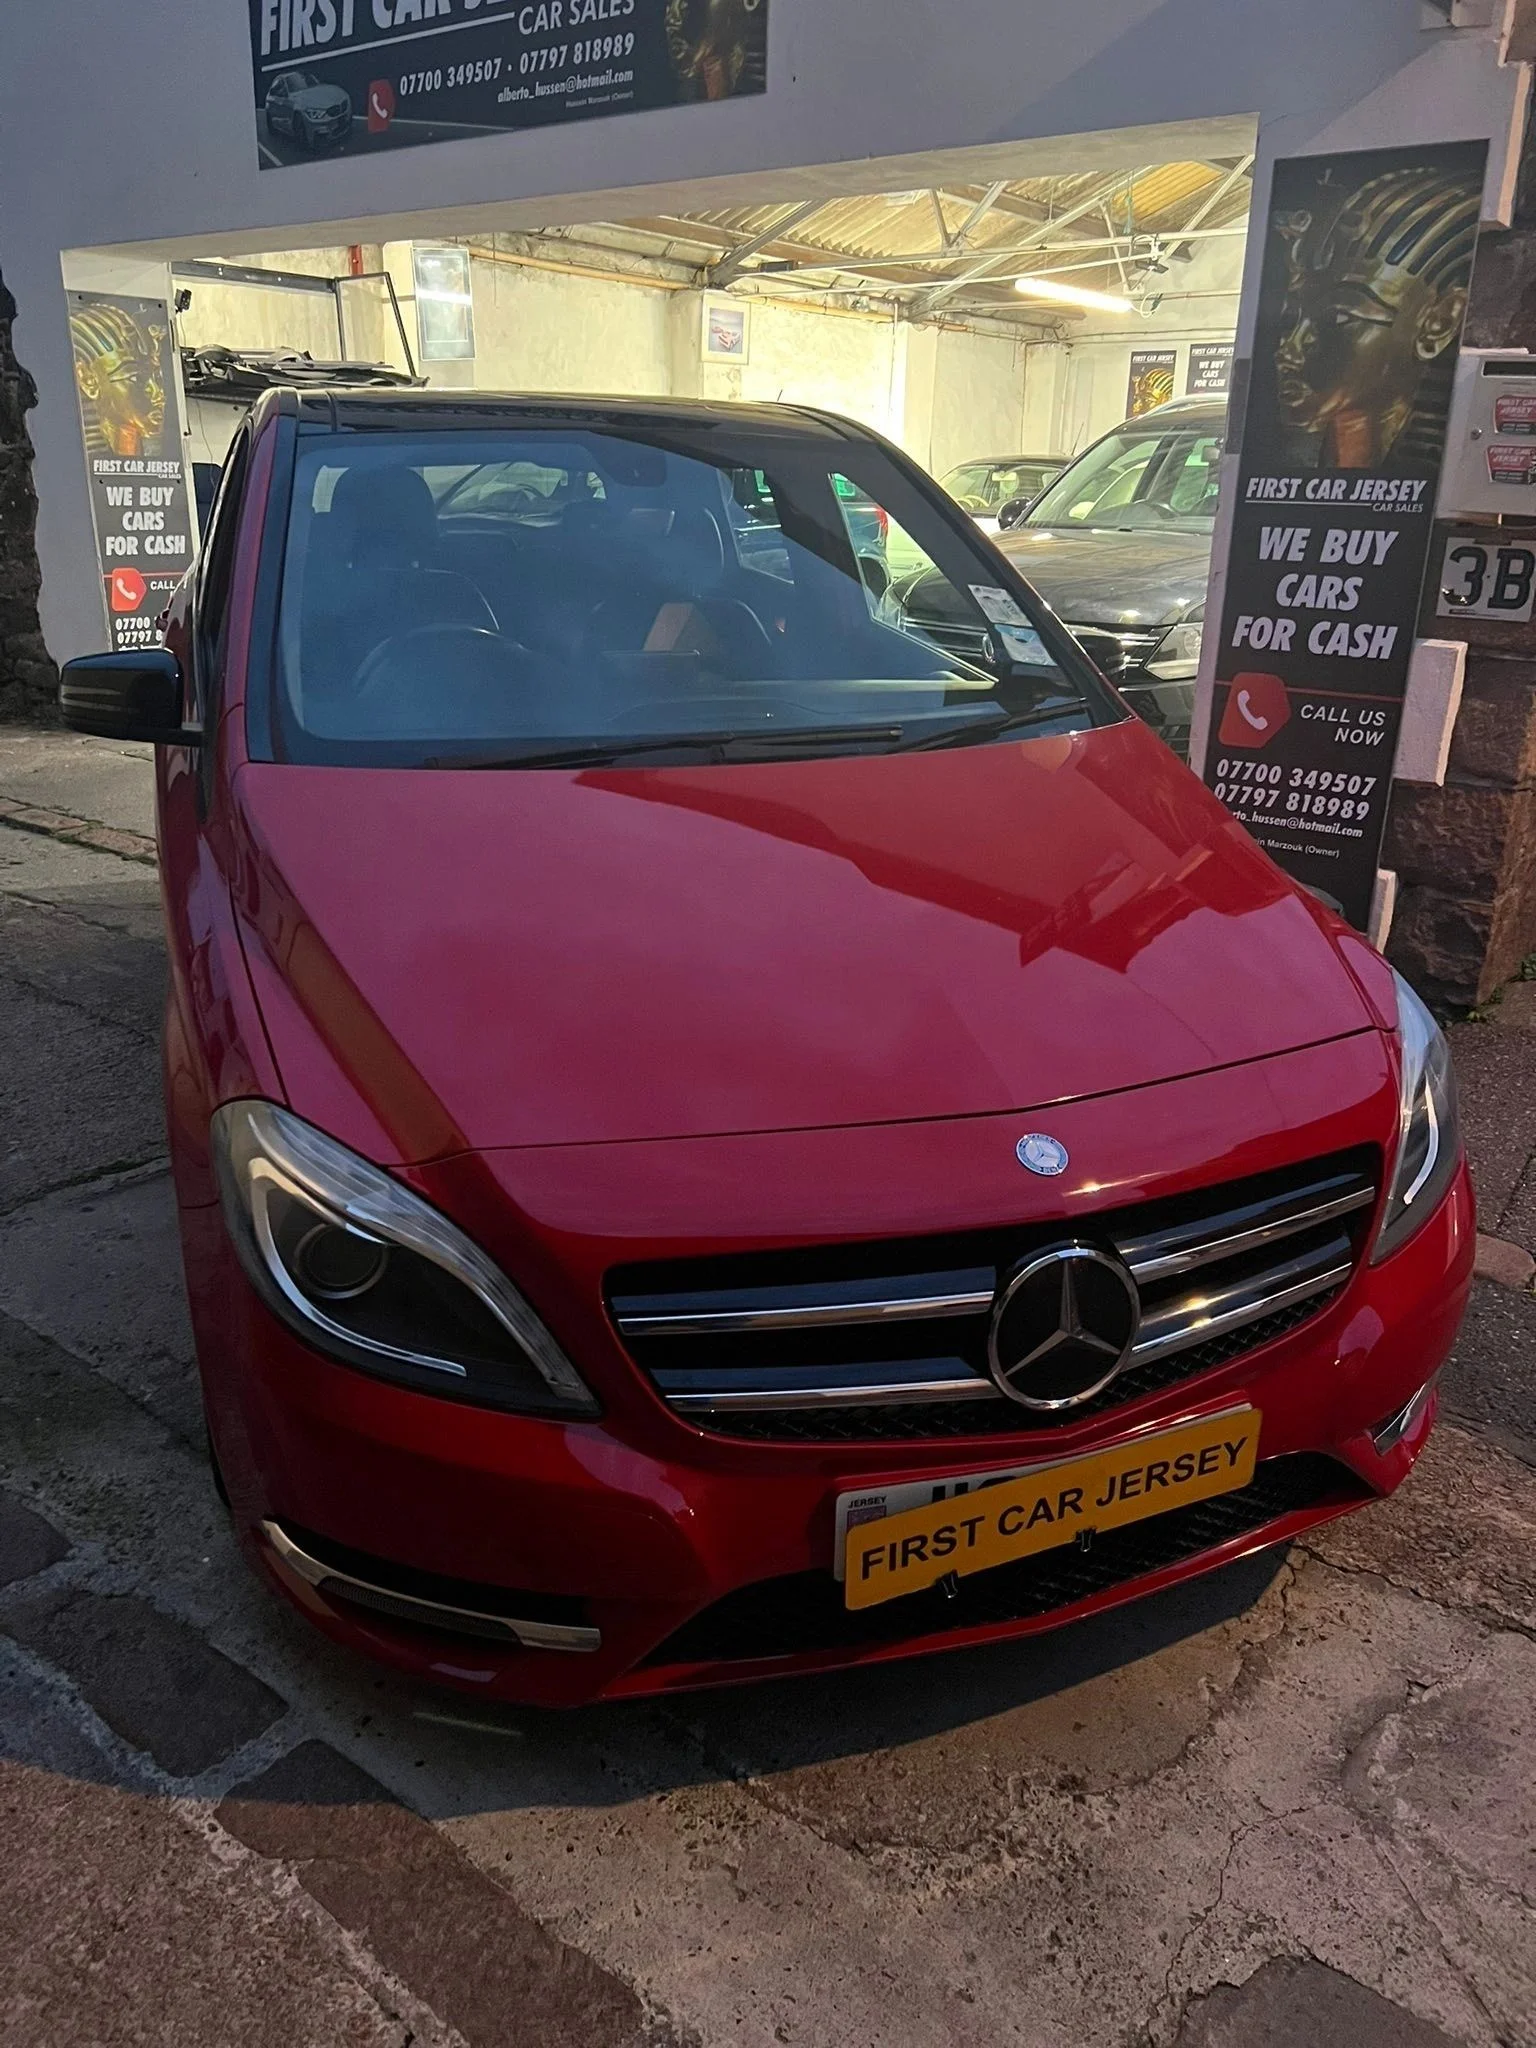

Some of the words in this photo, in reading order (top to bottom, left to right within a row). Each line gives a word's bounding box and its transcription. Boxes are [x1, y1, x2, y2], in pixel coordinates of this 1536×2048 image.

[518, 1, 563, 35] CAR
[568, 0, 636, 26] SALES
[400, 69, 442, 96] 07700
[446, 57, 502, 87] 349507
[519, 44, 568, 74] 07797
[573, 32, 635, 65] 818989
[497, 69, 633, 102] alberto_hussen@hotmail.com
[93, 459, 122, 472] FIRST
[123, 460, 145, 473] CAR
[146, 461, 180, 474] JERSEY
[106, 486, 133, 506] WE
[140, 486, 174, 506] BUY
[1246, 477, 1302, 499] FIRST
[1305, 478, 1347, 500] CAR
[1349, 479, 1428, 502] JERSEY
[1372, 503, 1393, 512] CAR
[1394, 503, 1424, 513] SALES
[122, 511, 165, 531] CARS
[105, 536, 138, 556] FOR
[144, 535, 186, 555] CASH
[1258, 526, 1311, 562] WE
[1319, 528, 1400, 566] BUY
[150, 580, 175, 591] CALL
[1441, 546, 1535, 610] 3B
[1275, 573, 1364, 612] CARS
[115, 616, 150, 631] 07700
[117, 630, 152, 644] 07797
[1231, 615, 1297, 652] FOR
[1307, 621, 1398, 660] CASH
[1300, 704, 1351, 724] CALL
[1358, 709, 1387, 727] US
[1334, 727, 1385, 747] NOW
[1216, 758, 1282, 785] 07700
[1289, 768, 1377, 796] 349507
[1214, 782, 1280, 808] 07797
[1285, 792, 1370, 821] 818989
[1267, 839, 1303, 852] Marzouk
[1304, 844, 1340, 858] (Owner)
[848, 1495, 887, 1509] JERSEY
[860, 1515, 986, 1581] FIRST
[997, 1486, 1085, 1537] CAR
[1094, 1436, 1249, 1508] JERSEY
